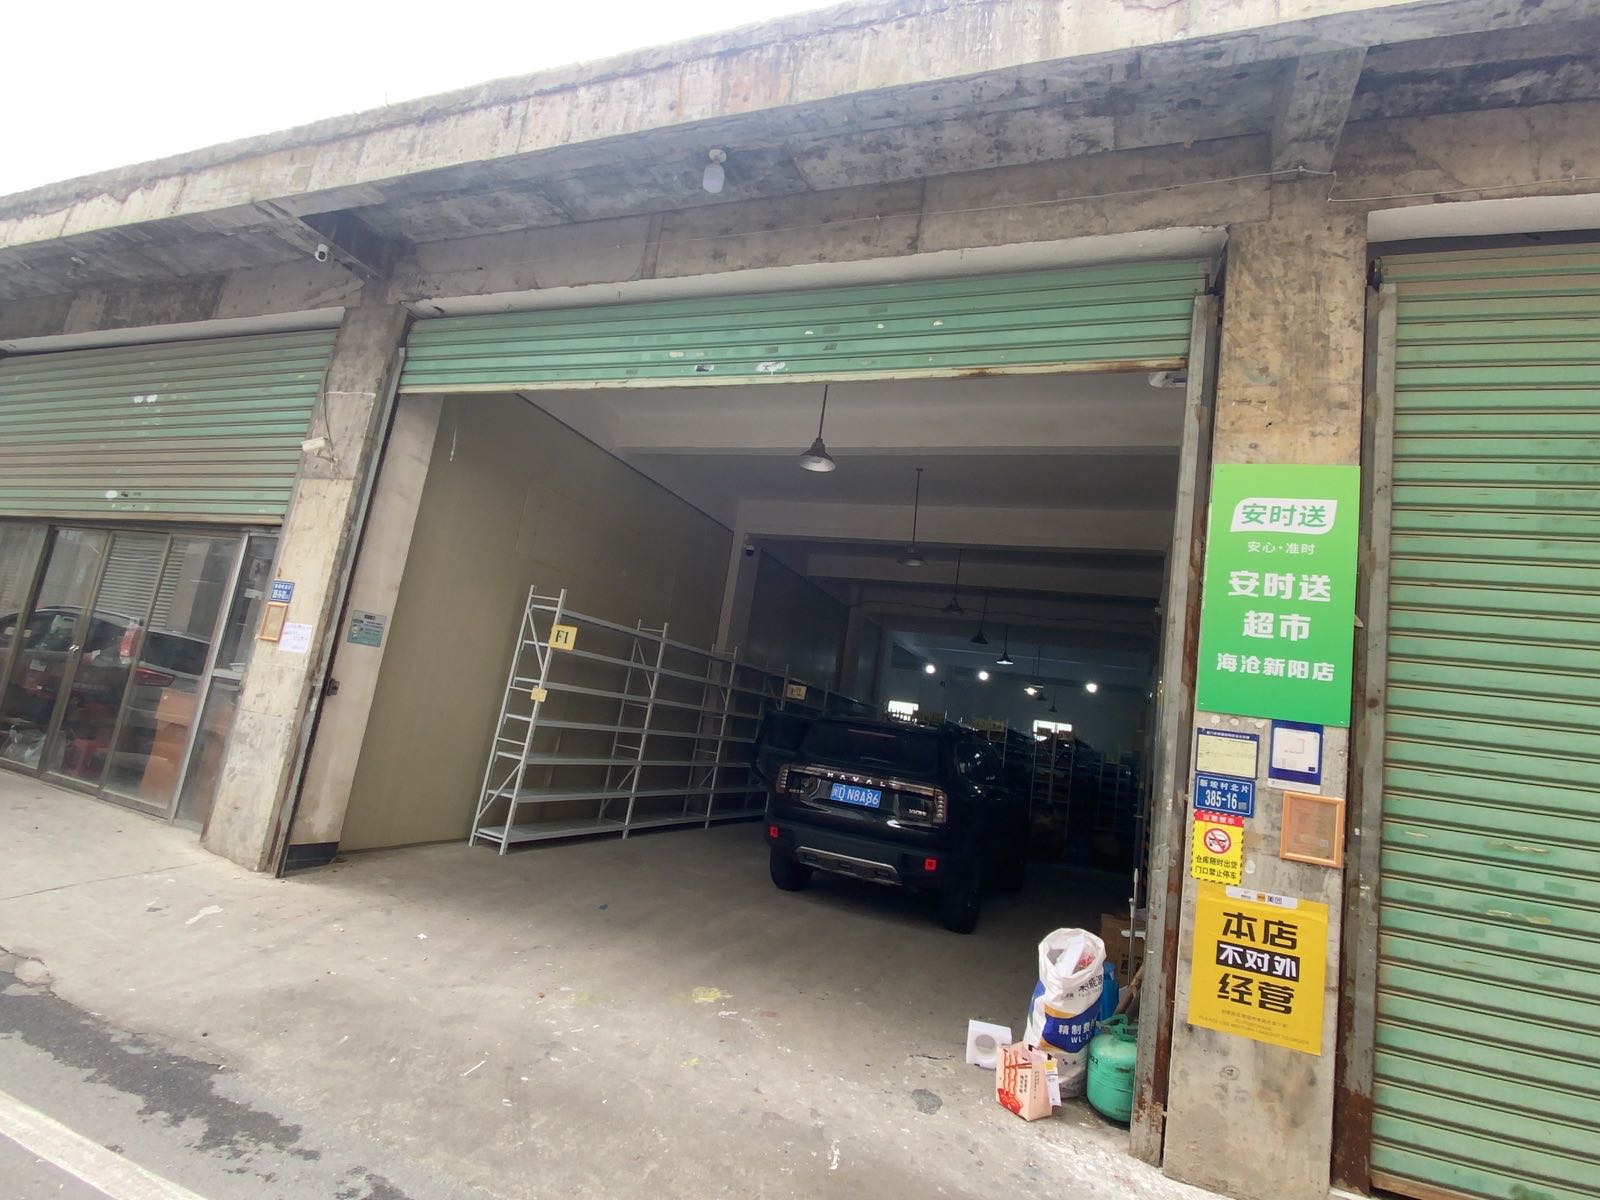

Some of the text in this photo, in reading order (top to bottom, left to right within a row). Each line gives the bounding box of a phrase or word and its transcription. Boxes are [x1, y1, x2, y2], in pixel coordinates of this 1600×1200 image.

[1241, 503, 1327, 528] 安时送
[1247, 541, 1315, 556] 安心·准时
[1228, 570, 1331, 602] 安时送
[1242, 610, 1311, 642] 超市
[1216, 653, 1335, 682] 海沧新阳店
[827, 772, 886, 787] HAVAL
[1205, 789, 1237, 810] 385-16
[1195, 866, 1237, 880] 门口禁止停车
[1222, 912, 1298, 950] 本店
[1219, 943, 1297, 977] 不对外
[1217, 973, 1295, 1015] 经营
